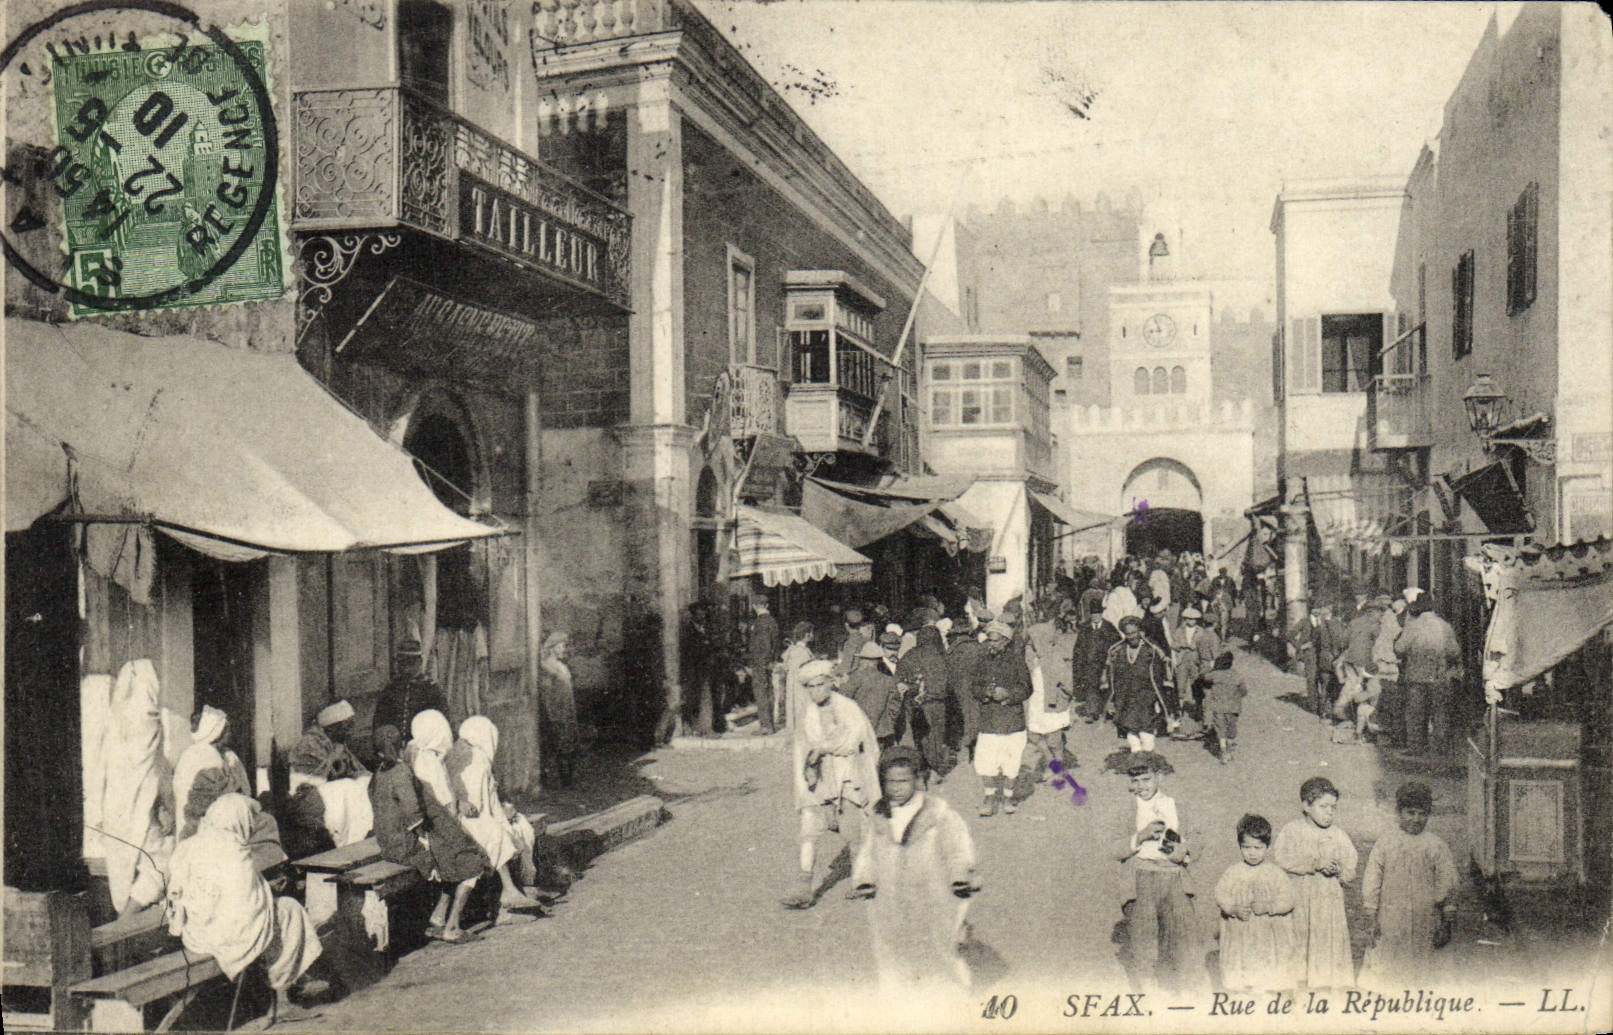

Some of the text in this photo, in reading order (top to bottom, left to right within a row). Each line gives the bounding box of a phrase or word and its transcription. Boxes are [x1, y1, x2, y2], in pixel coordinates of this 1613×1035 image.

[132, 91, 190, 150] 10
[123, 154, 185, 216] 22
[472, 187, 599, 283] TAILLEUR
